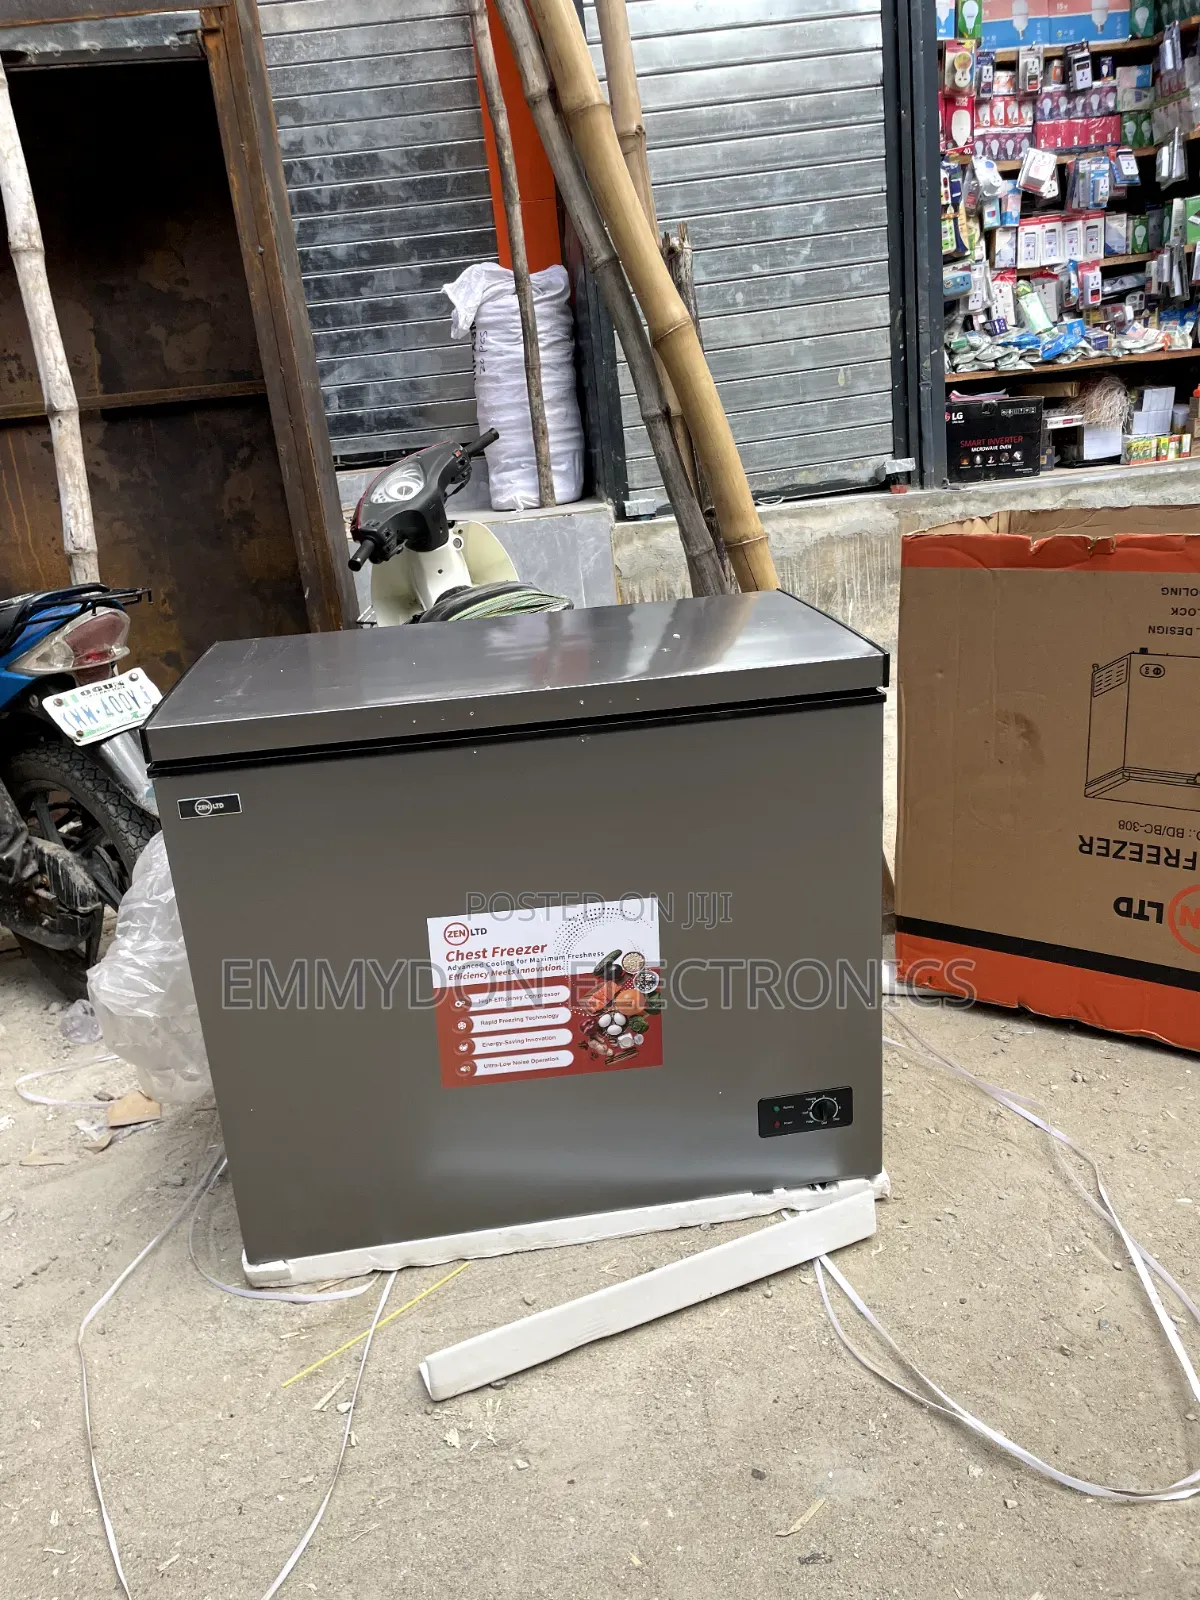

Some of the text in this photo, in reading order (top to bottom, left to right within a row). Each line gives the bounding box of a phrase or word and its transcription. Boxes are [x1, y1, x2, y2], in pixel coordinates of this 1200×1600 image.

[951, 411, 964, 420] LG
[960, 435, 1024, 448] SMART INVERTER
[1161, 587, 1200, 597] OLING
[1148, 625, 1193, 636] DESIGN
[1118, 820, 1185, 839] BD/BC-308
[1078, 834, 1198, 871] FREEZER
[1113, 896, 1164, 925] LTD
[446, 927, 488, 938] ZEN LTD
[445, 943, 548, 962] Chest Freezer
[447, 951, 605, 972] Advanced Cooling for Maximum Freshness
[448, 971, 489, 981] Efficiency
[491, 968, 515, 977] Meets
[524, 991, 561, 1000] Compressor
[482, 1038, 525, 1047] Energy-Saving
[483, 1061, 512, 1069] Ultra-Low
[530, 1056, 559, 1064] Operation
